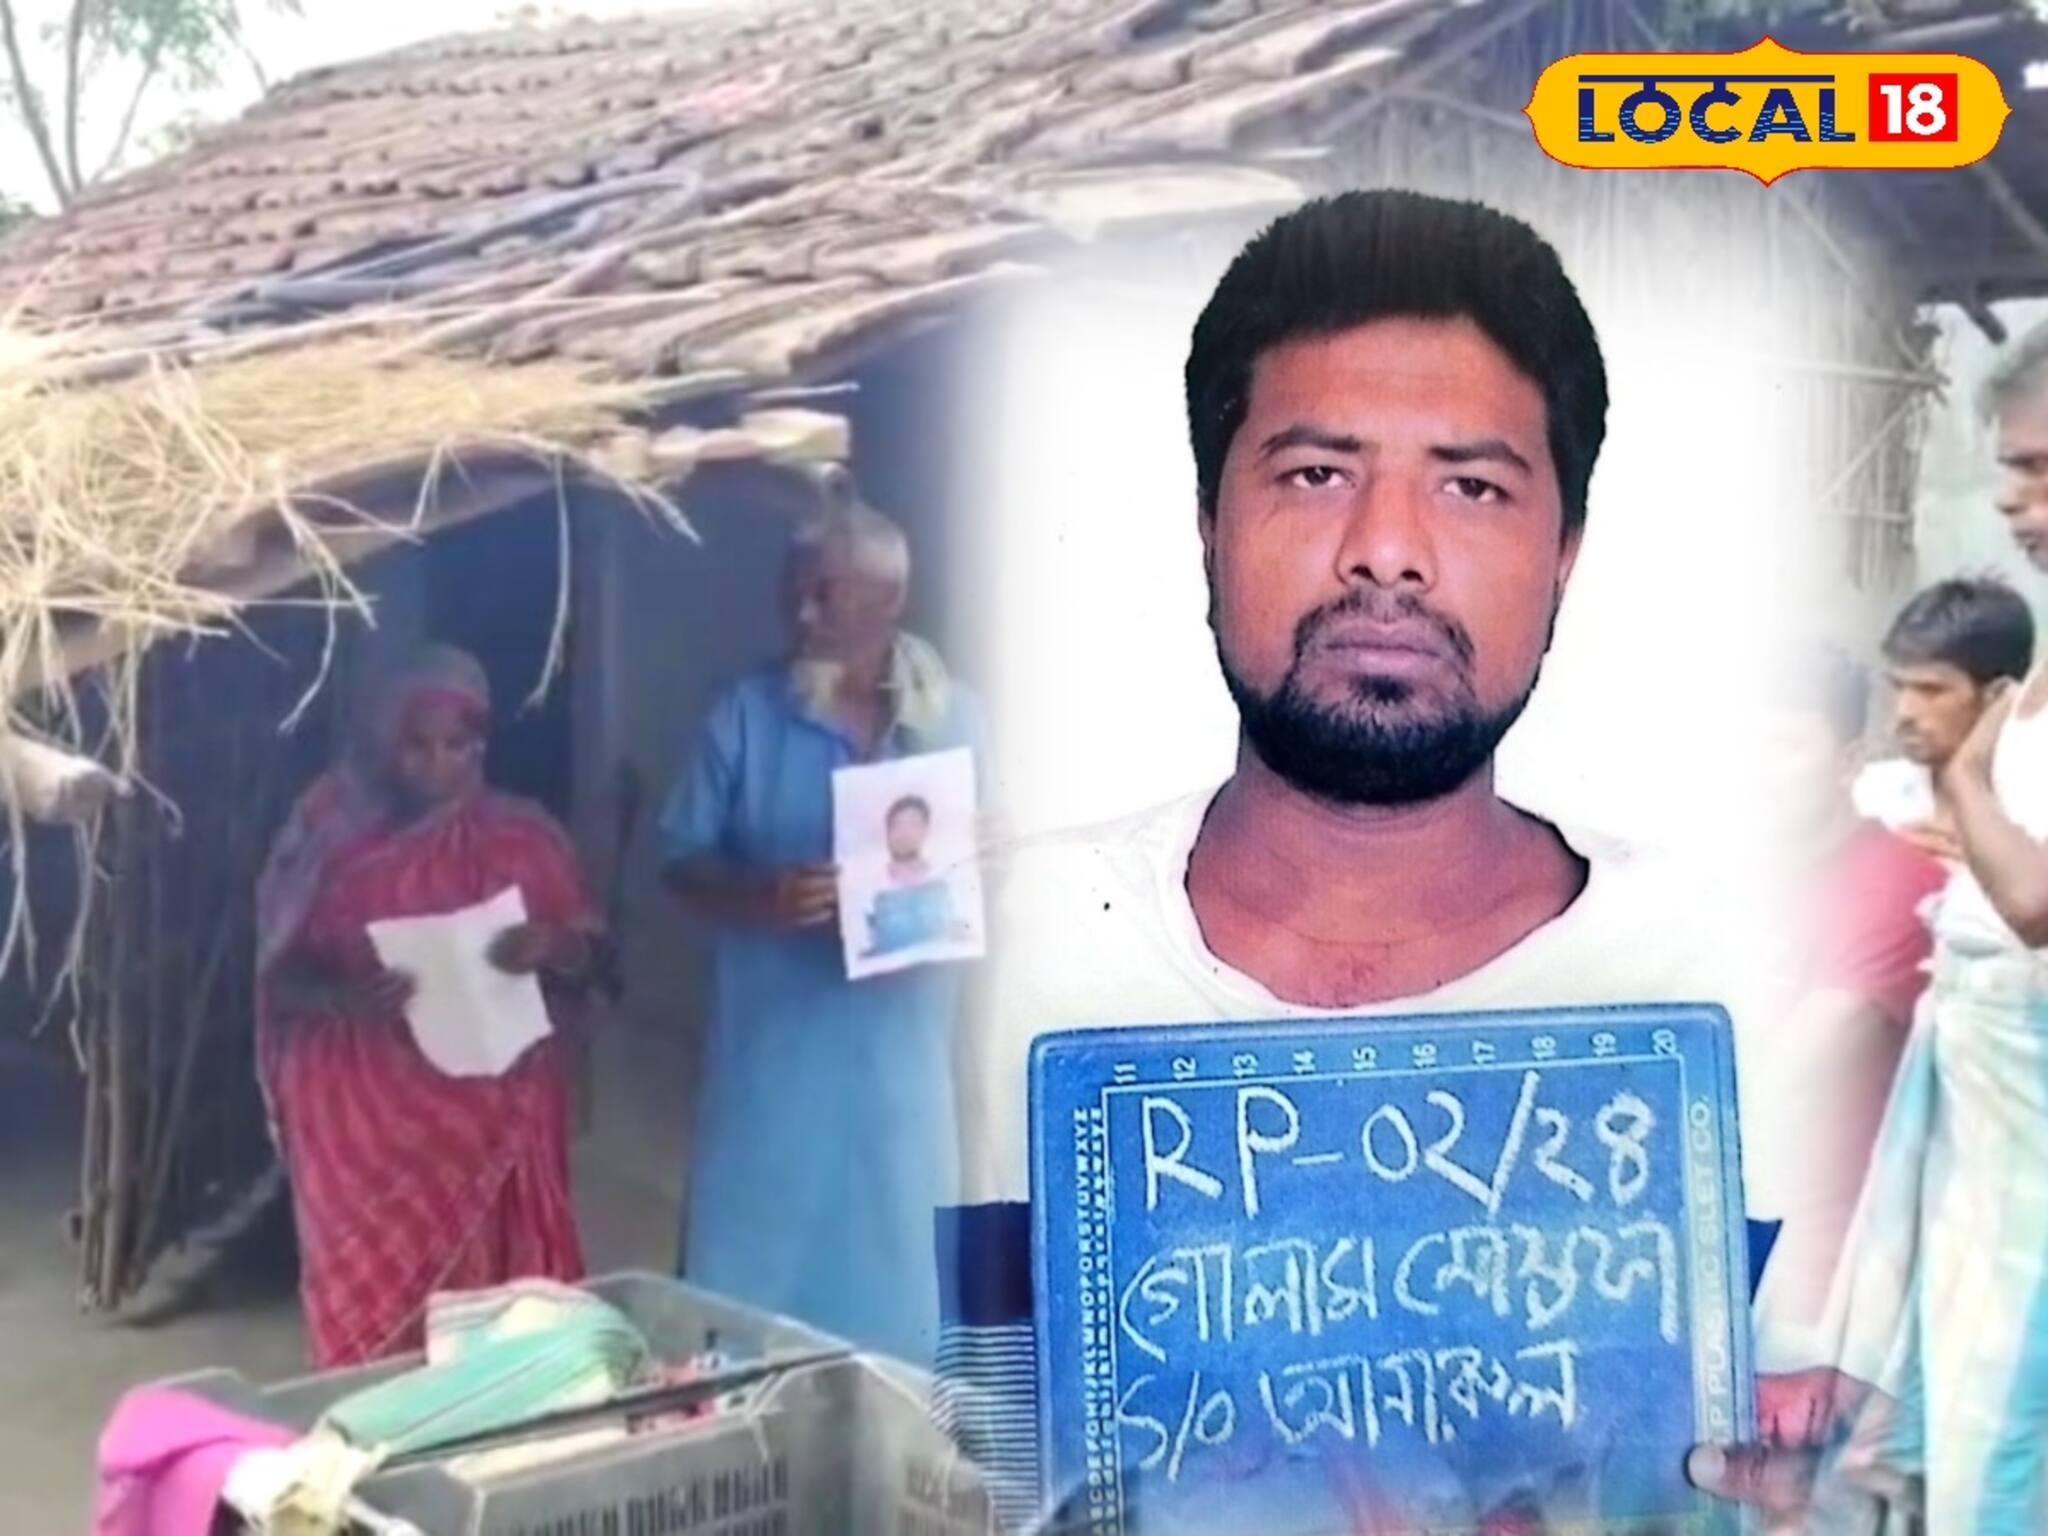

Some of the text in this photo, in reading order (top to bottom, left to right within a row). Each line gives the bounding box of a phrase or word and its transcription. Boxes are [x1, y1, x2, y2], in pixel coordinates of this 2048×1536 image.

[1113, 1028, 1677, 1085] 11 12 13 14 15 16 17 18 19 20
